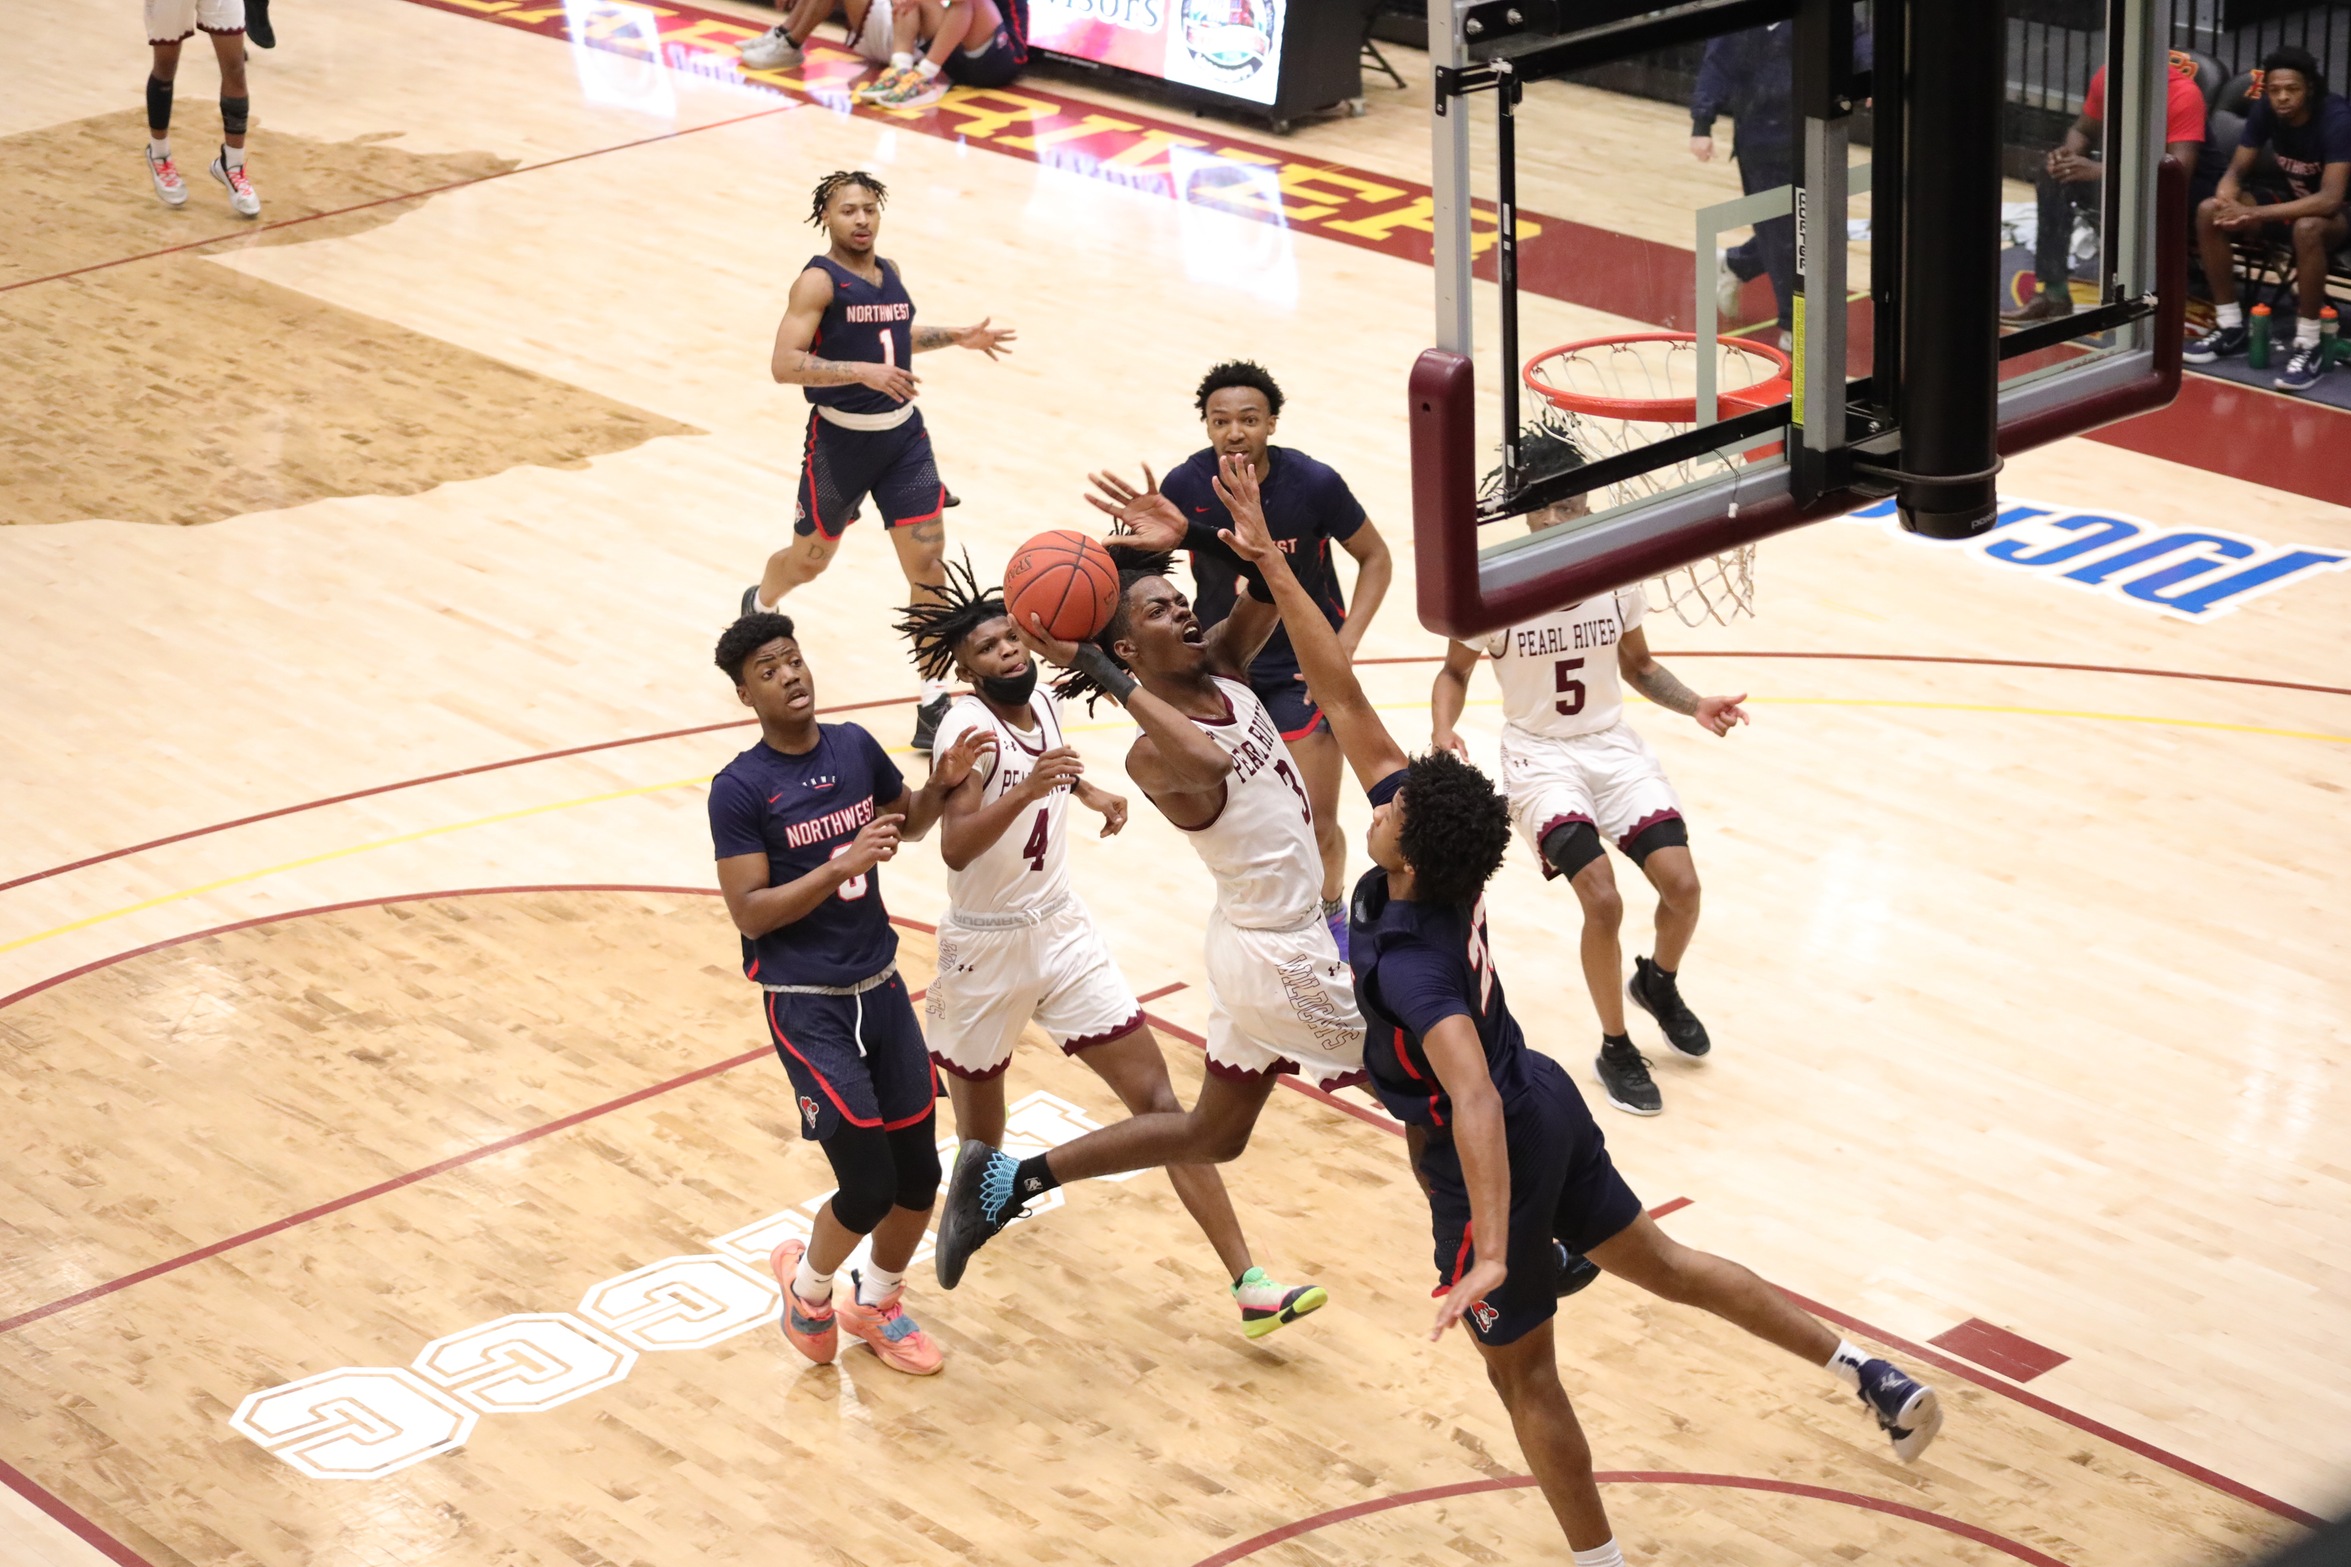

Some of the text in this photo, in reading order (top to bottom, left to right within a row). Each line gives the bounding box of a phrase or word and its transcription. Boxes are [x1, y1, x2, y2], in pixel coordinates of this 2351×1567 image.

[871, 85, 1542, 259] RIVER
[846, 303, 910, 323] NORTHWEST
[879, 328, 896, 367] 1
[1517, 618, 1617, 658] PEARL RIVER
[1555, 656, 1586, 716] 5
[1248, 699, 1275, 752] RIV
[785, 793, 876, 849] NORTHWEST
[1274, 759, 1311, 826] 3
[1023, 807, 1049, 871] 4
[1276, 953, 1361, 1051] WILDCATS
